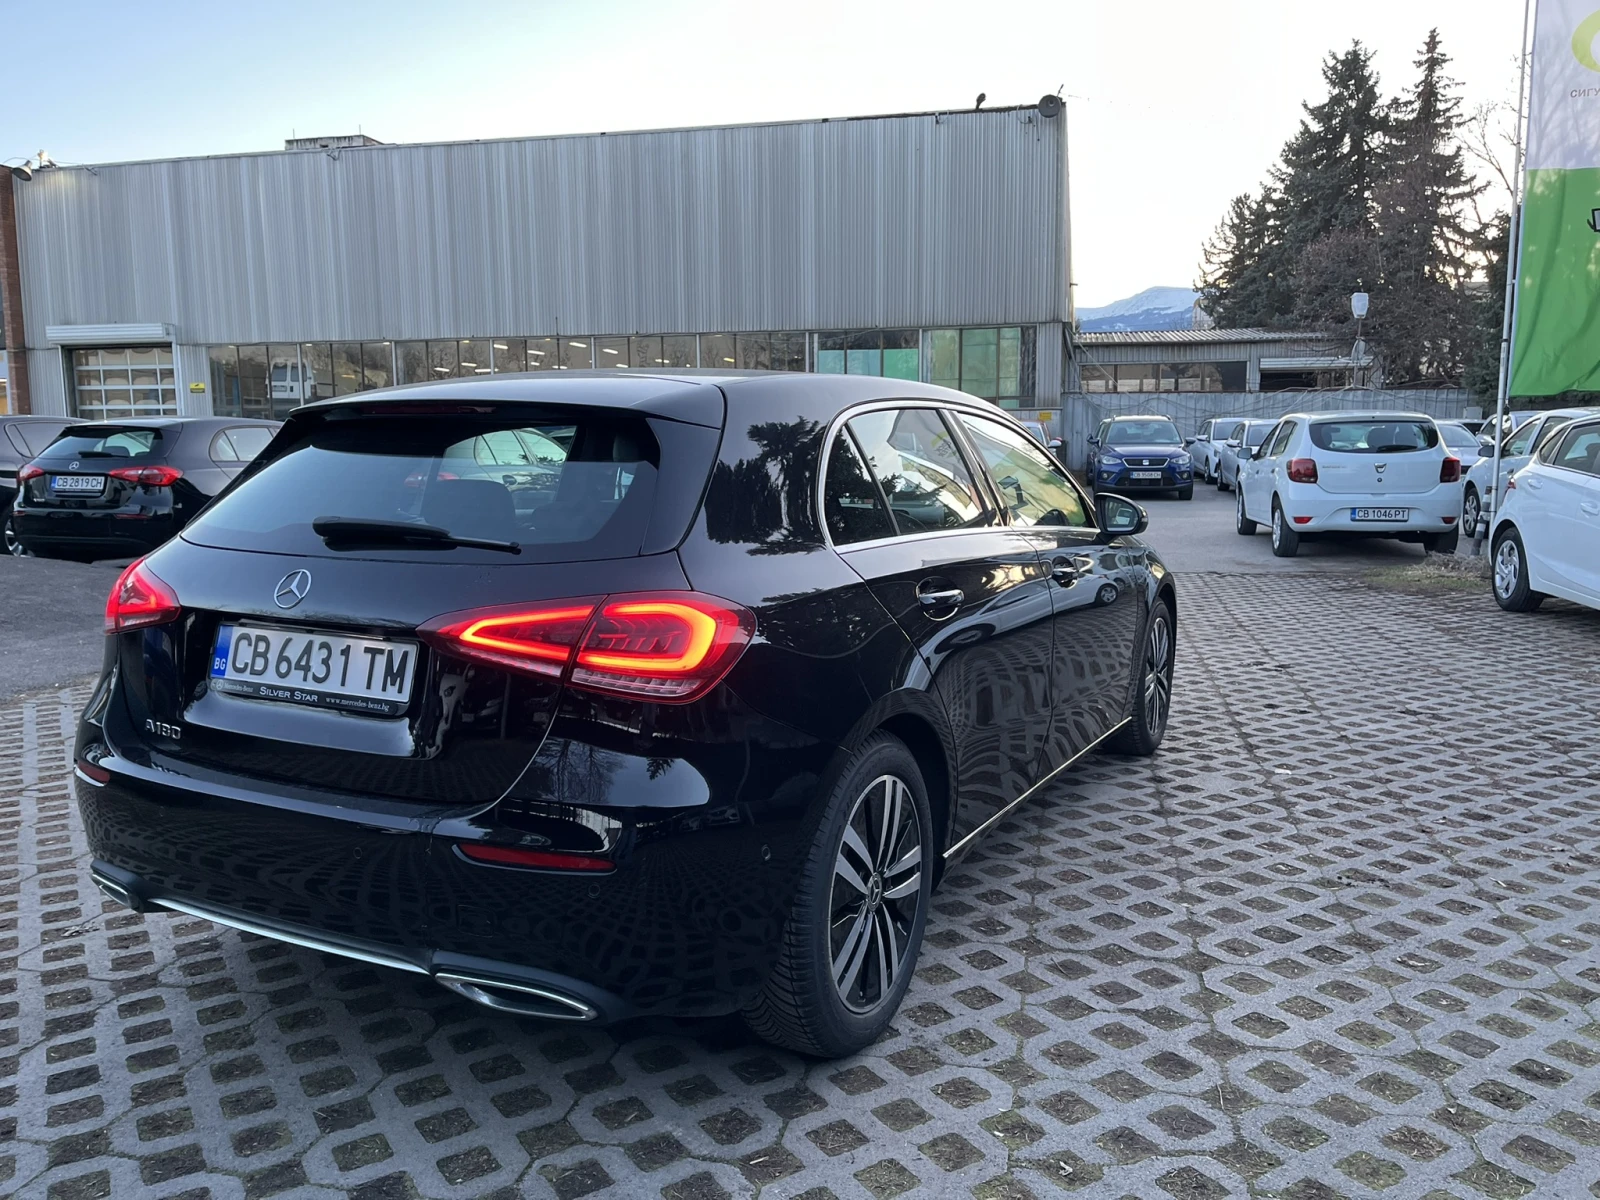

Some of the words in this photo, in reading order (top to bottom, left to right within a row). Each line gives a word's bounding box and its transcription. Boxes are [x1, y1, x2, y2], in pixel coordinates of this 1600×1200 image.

[57, 477, 68, 487] CB
[69, 478, 89, 487] 2819
[91, 478, 102, 488] CH
[1357, 510, 1370, 518] CB
[1372, 510, 1393, 518] 1046
[1394, 510, 1407, 518] PT
[213, 657, 226, 671] BG
[231, 632, 271, 676] CB
[275, 636, 352, 687] 6431
[363, 645, 409, 694] TM
[325, 697, 390, 713] www.mercedes-benz.bg
